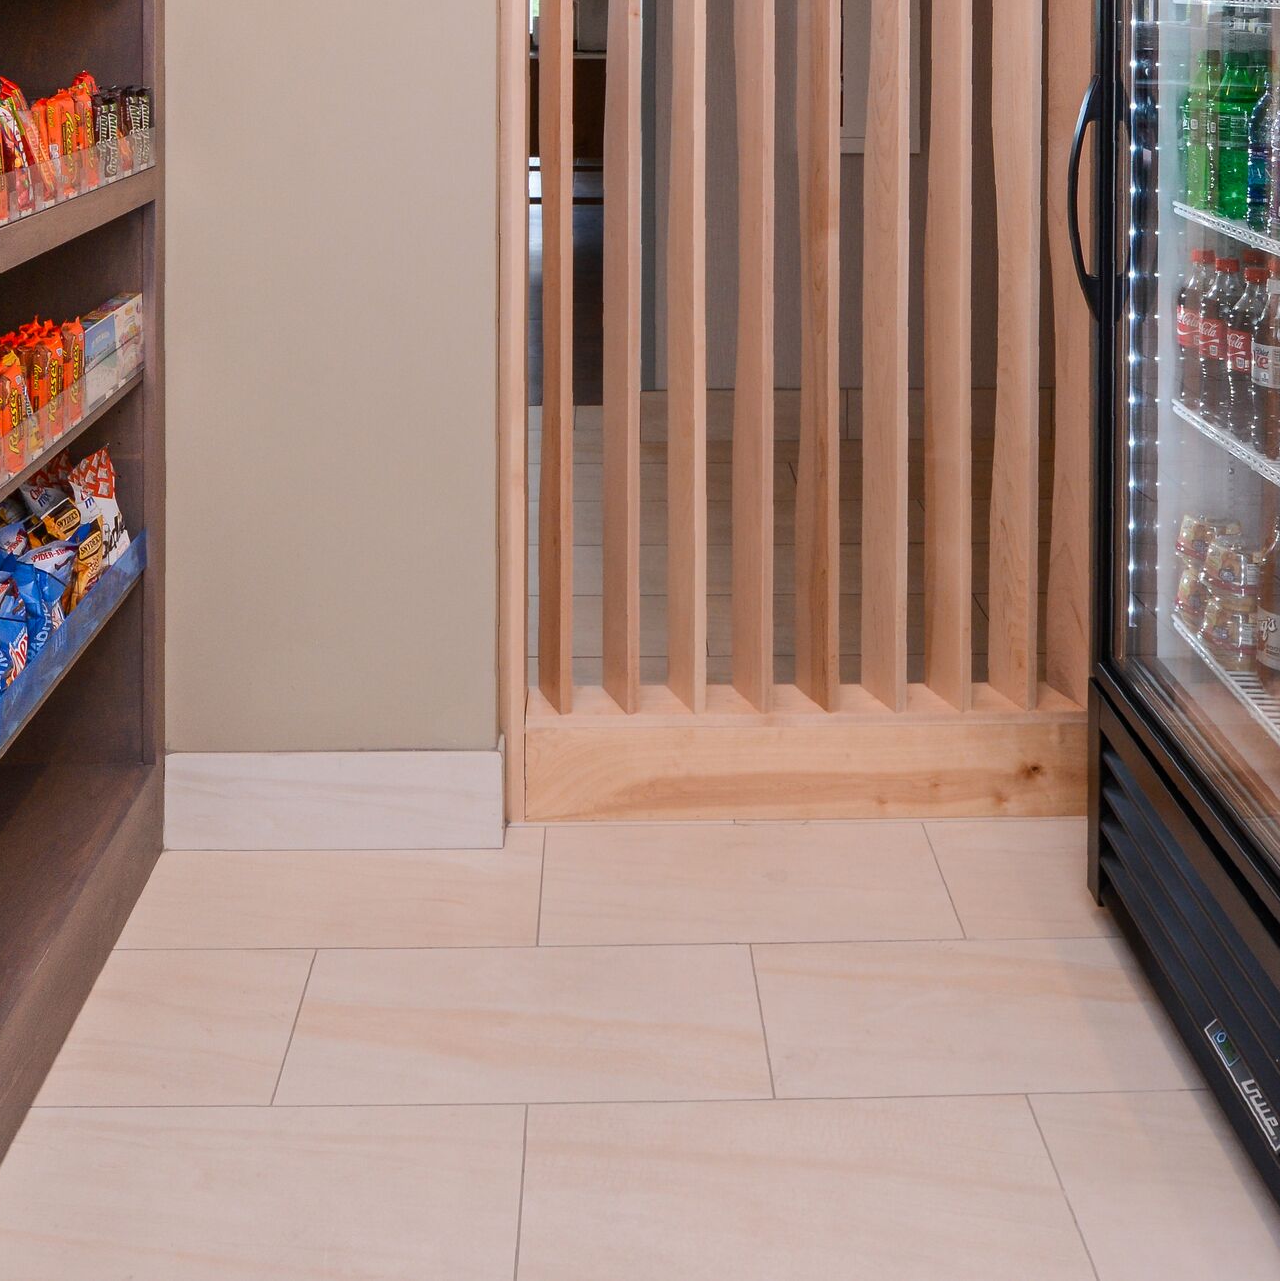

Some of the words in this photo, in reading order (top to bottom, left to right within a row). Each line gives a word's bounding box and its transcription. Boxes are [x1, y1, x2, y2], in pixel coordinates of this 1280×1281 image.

[9, 389, 20, 455] Reese's
[48, 360, 58, 422] Reese's
[80, 532, 102, 557] SNYDER'S
